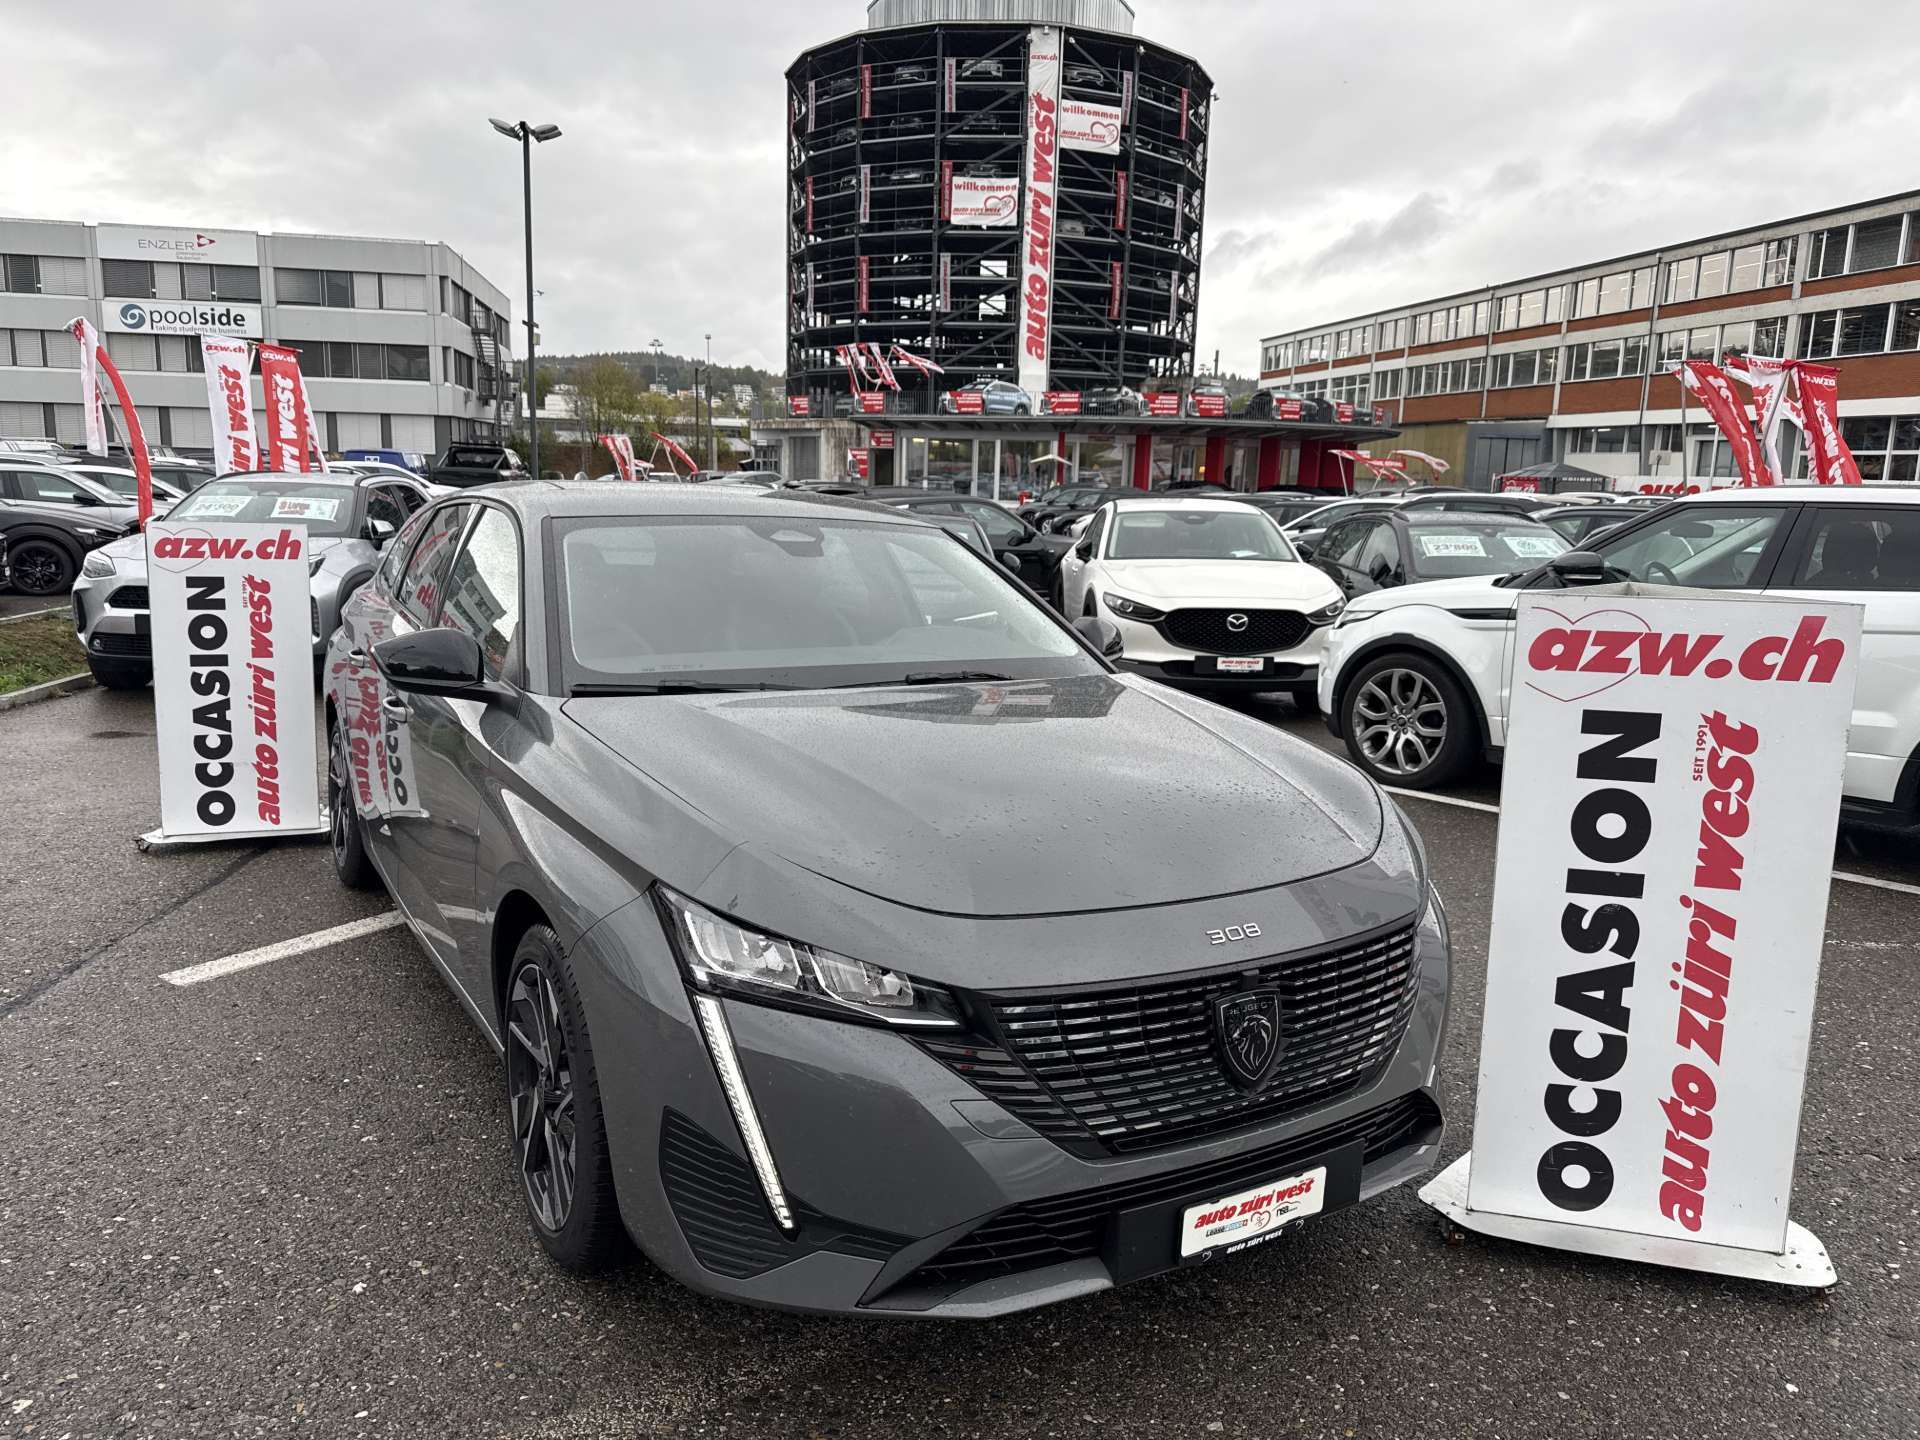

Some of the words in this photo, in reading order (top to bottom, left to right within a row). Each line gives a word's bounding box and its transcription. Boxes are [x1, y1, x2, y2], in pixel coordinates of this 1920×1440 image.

[1031, 91, 1056, 183] west
[1062, 105, 1120, 121] willkommen
[954, 180, 1017, 192] willkommen
[138, 239, 195, 251] ENZLER
[1024, 186, 1052, 273] züri
[150, 306, 246, 330] poolside
[155, 325, 178, 333] taking
[178, 325, 206, 334] students
[205, 344, 246, 354] azw.ch
[1024, 273, 1048, 361] auto
[261, 352, 297, 363] azw.ch
[218, 364, 249, 432] west
[272, 373, 298, 439] west
[154, 529, 302, 560] azw.ch
[243, 573, 274, 659] west
[1527, 616, 1846, 684] azw.ch
[185, 575, 236, 827] OCCASION
[247, 662, 278, 743] züri
[1692, 757, 1705, 782] SEIT
[1695, 724, 1708, 752] 1991
[251, 743, 281, 826] auto
[1693, 710, 1759, 892] west
[1206, 922, 1262, 945] 308
[1537, 709, 1663, 1212] OCCASION
[1669, 895, 1738, 1066] züri
[1658, 1063, 1717, 1233] auto
[1194, 1204, 1236, 1229] auto
[1237, 1189, 1276, 1217] züri
[1275, 1177, 1316, 1204] west
[1226, 1242, 1246, 1254] auto
[1247, 1234, 1265, 1247] züri
[1264, 1228, 1283, 1242] west
